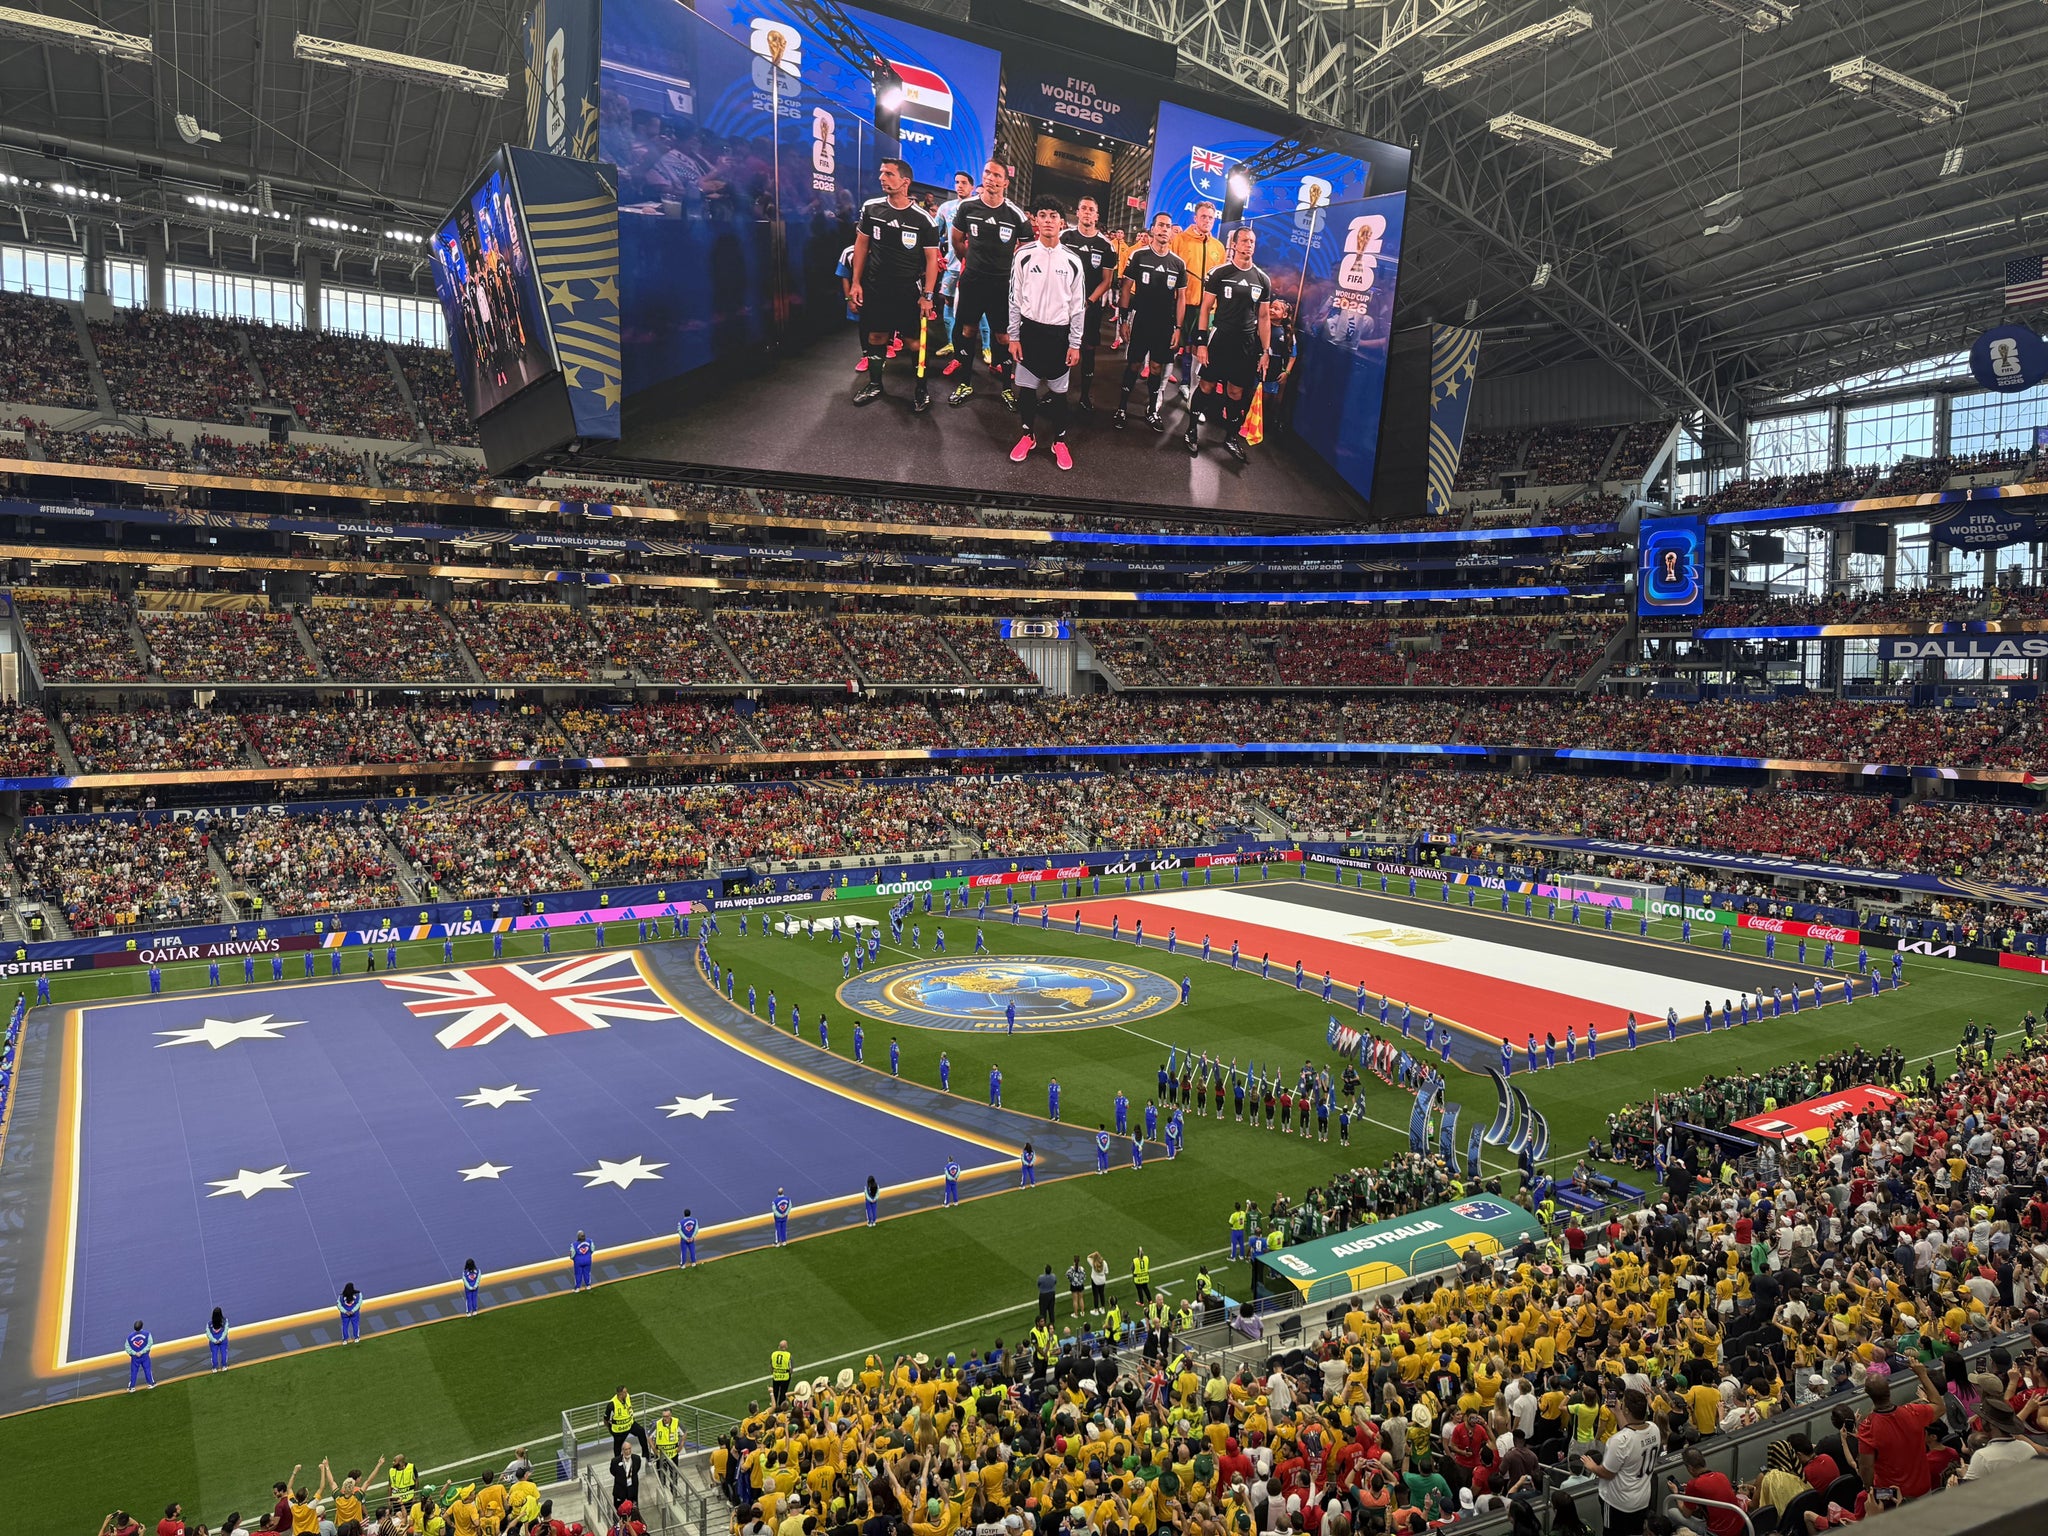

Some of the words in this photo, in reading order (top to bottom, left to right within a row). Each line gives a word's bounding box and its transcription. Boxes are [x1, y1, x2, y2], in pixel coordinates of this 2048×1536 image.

[1067, 77, 1097, 95] FIFA
[784, 99, 801, 107] CUP
[1041, 83, 1092, 107] WORLD
[1093, 99, 1121, 115] CUP
[752, 100, 801, 119] 2026
[1054, 102, 1104, 124] 2026
[819, 159, 830, 168] FIFA
[813, 179, 835, 192] 2026
[1347, 274, 1363, 284] FIFA
[1335, 289, 1356, 300] WORLD
[1356, 294, 1370, 303] CUP
[1332, 298, 1368, 315] 2026
[1997, 378, 2025, 387] 2026
[40, 505, 95, 516] #FIFAWorldCup
[1969, 515, 1997, 524] FIFA
[337, 524, 393, 533] DALLAS
[1949, 525, 1994, 535] WORLD
[1995, 522, 2022, 532] CUP
[536, 535, 554, 543] FIFA
[554, 537, 583, 545] WORLD
[600, 539, 627, 547] 2026
[1963, 533, 2009, 543] 2026
[749, 548, 793, 556] DALLAS
[1455, 559, 1499, 567] DALLAS
[1893, 639, 2048, 658] DALLAS
[1151, 858, 1180, 871] KIA
[1311, 853, 1326, 863] ADI
[1326, 856, 1371, 870] PREDICTSTREET
[1376, 862, 1406, 875] QATAR
[1409, 866, 1448, 881] AIRWAYS
[1588, 840, 1640, 851] FIFA
[1643, 846, 1735, 861] WORLD
[1735, 856, 1795, 867] CUP
[1792, 864, 1903, 880] 2026
[1056, 866, 1081, 879] Coca-Cola
[1104, 861, 1137, 875] KIA
[1509, 866, 1525, 875] FIFA
[976, 873, 1003, 886] Coca-Cola
[1017, 869, 1042, 882] Coca-Cola
[1477, 875, 1506, 890] VISA
[876, 879, 932, 896] aramco
[715, 899, 734, 909] FIFA
[733, 897, 765, 907] WORLD
[765, 894, 783, 904] CUP
[1651, 901, 1716, 922] aramco
[441, 920, 483, 937] VISA
[1747, 916, 1785, 932] Coca-Cola
[356, 927, 401, 945] VISA
[1806, 924, 1846, 942] Coca-Cola
[153, 936, 182, 948] FIFA
[1898, 938, 1957, 959] KIA
[139, 945, 201, 965] QATAR
[207, 938, 281, 957] AIRWAYS
[1104, 965, 1149, 979] FIFA
[858, 999, 900, 1016] FIFA
[1026, 1017, 1092, 1029] WORLD
[1095, 1009, 1127, 1023] CUP
[1127, 995, 1163, 1014] 2026
[1808, 1100, 1853, 1116] EGYPT
[1330, 1220, 1445, 1259] AUSTRALIA
[1635, 1446, 1658, 1478] 10
[821, 1477, 828, 1490] 4
